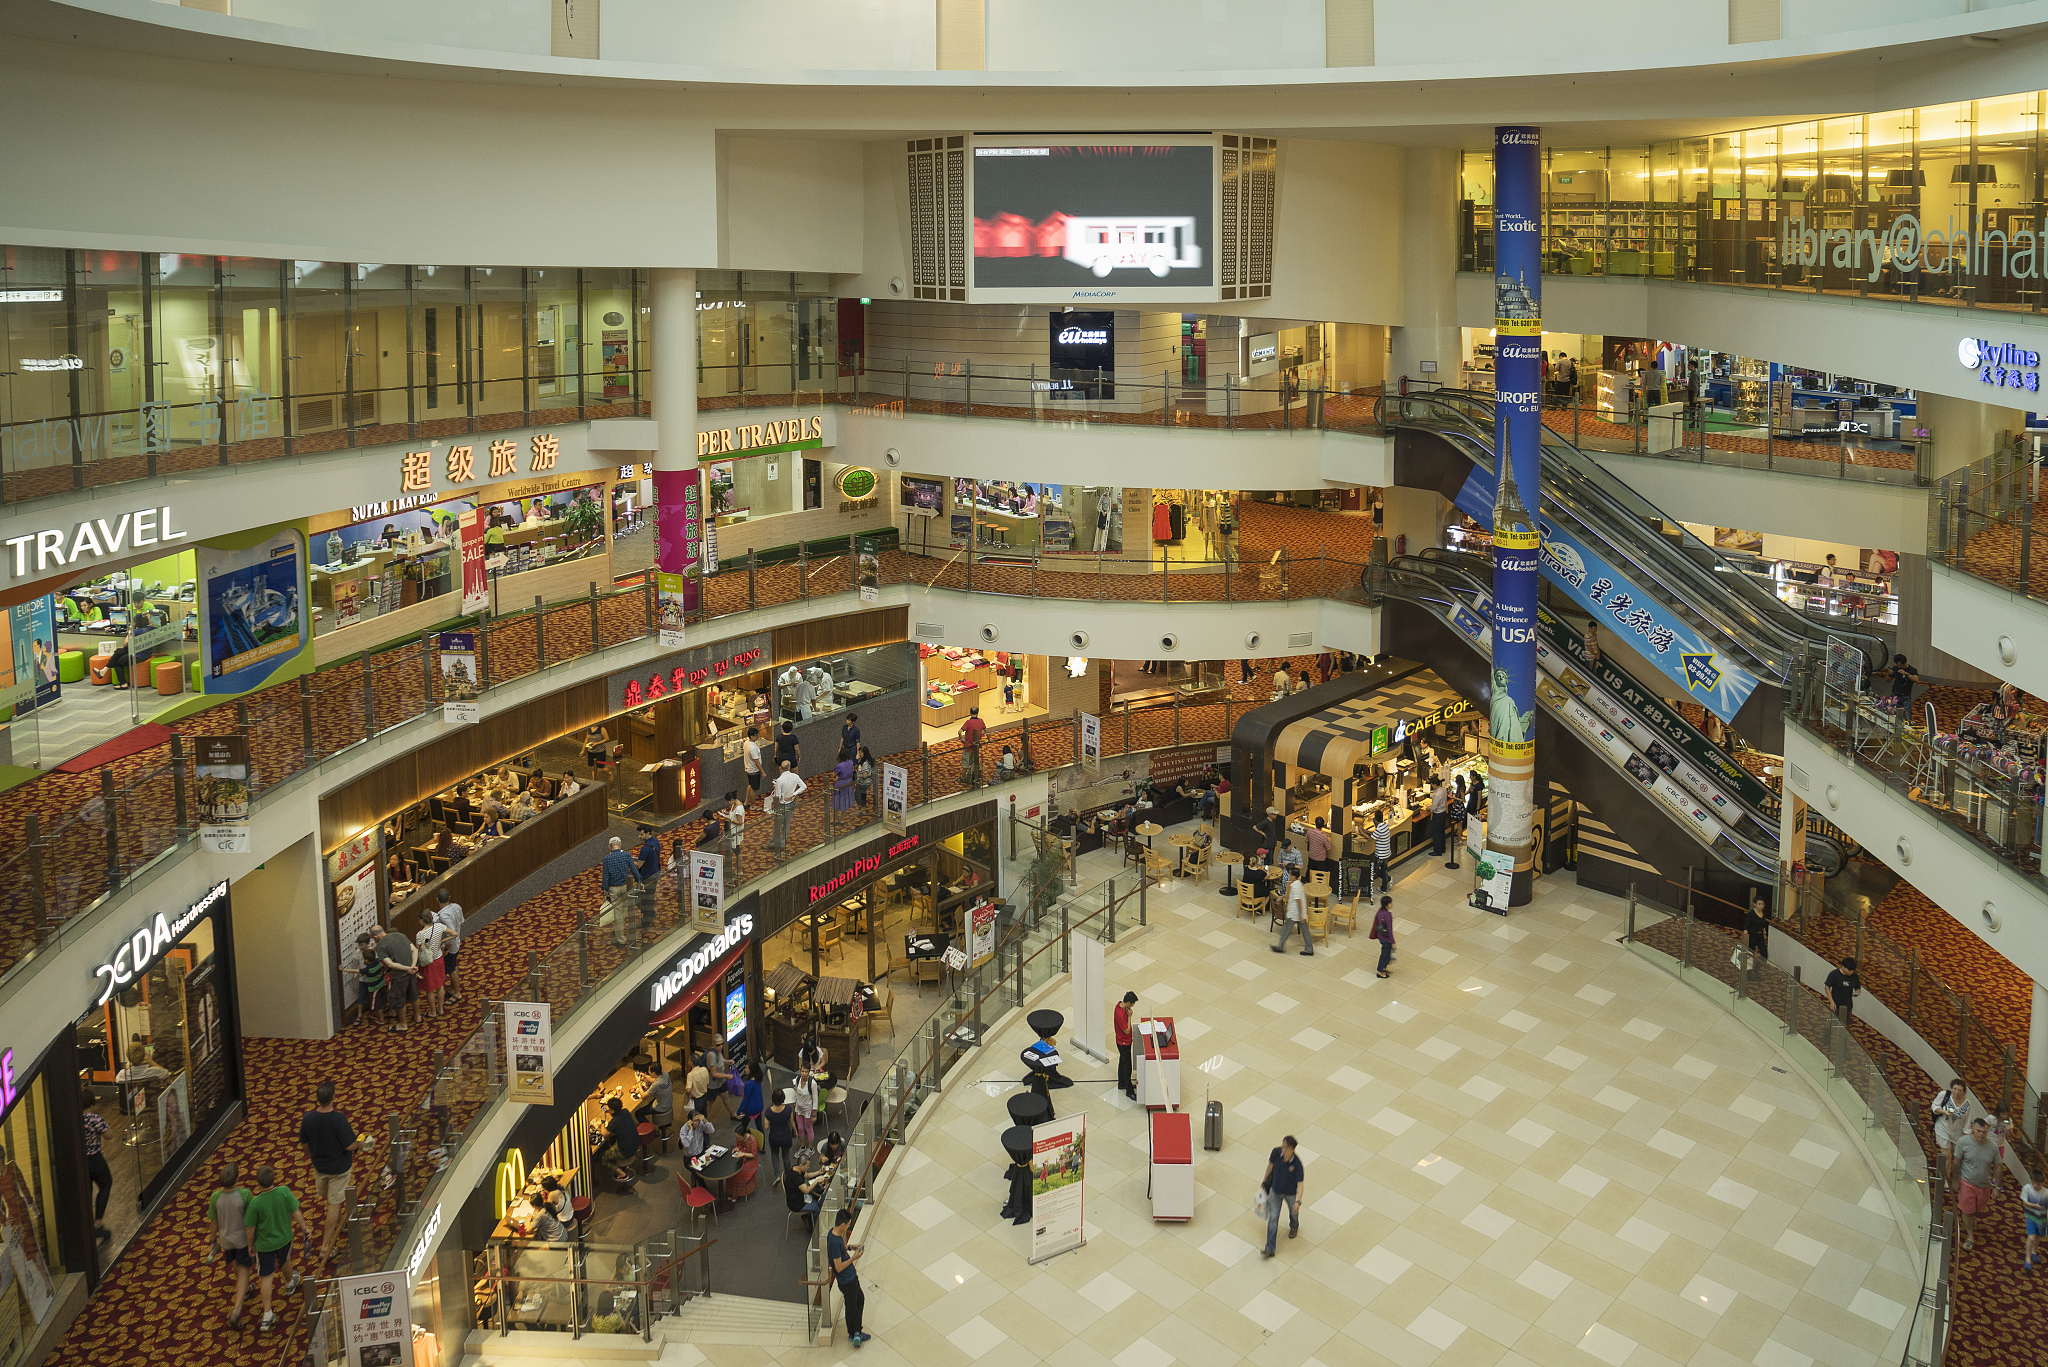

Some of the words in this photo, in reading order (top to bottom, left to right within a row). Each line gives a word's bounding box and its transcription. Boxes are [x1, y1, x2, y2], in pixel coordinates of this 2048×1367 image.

[1500, 220, 1537, 232] Exotic
[139, 387, 270, 455] 图书馆
[736, 416, 822, 451] TRAVELS
[401, 433, 560, 493] 超级旅游
[508, 484, 540, 498] Worldwide
[541, 480, 560, 492] Travel
[562, 478, 582, 488] Centre
[684, 485, 698, 559] 超级旅游
[6, 506, 188, 577] TRAVEL
[462, 536, 478, 548] urope
[462, 545, 484, 564] SALE
[1540, 549, 1582, 589] Travel
[17, 598, 44, 618] EUROPE
[1496, 602, 1500, 610] A
[1502, 604, 1524, 614] Unique
[1590, 577, 1676, 654] 星光旅游
[1496, 614, 1528, 624] Experience
[1502, 627, 1536, 644] USA
[230, 654, 248, 666] DECKS
[688, 668, 708, 683] DIN
[712, 660, 729, 673] TAI
[732, 648, 760, 666] FUNG
[1692, 657, 1706, 670] VISIT
[1704, 666, 1712, 676] US
[1596, 696, 1610, 710] ICBC
[1603, 669, 1623, 690] US
[1622, 688, 1644, 706] AT
[1643, 704, 1692, 744] #B1-37
[1405, 710, 1441, 737] CAFE
[1574, 708, 1588, 721] ICBC
[1704, 750, 1742, 778] SUBWAY
[1686, 772, 1700, 785] ICBC
[1666, 786, 1680, 800] ICBC
[810, 853, 882, 904] RamenPlay
[171, 880, 227, 938] Hairdressing
[652, 913, 753, 1012] McDonald's
[514, 1010, 530, 1018] ICBC
[512, 1036, 546, 1044] 环游世界
[354, 1286, 378, 1296] ICBC
[362, 1300, 391, 1310] UnionPay
[352, 1318, 403, 1332] 环游世界
